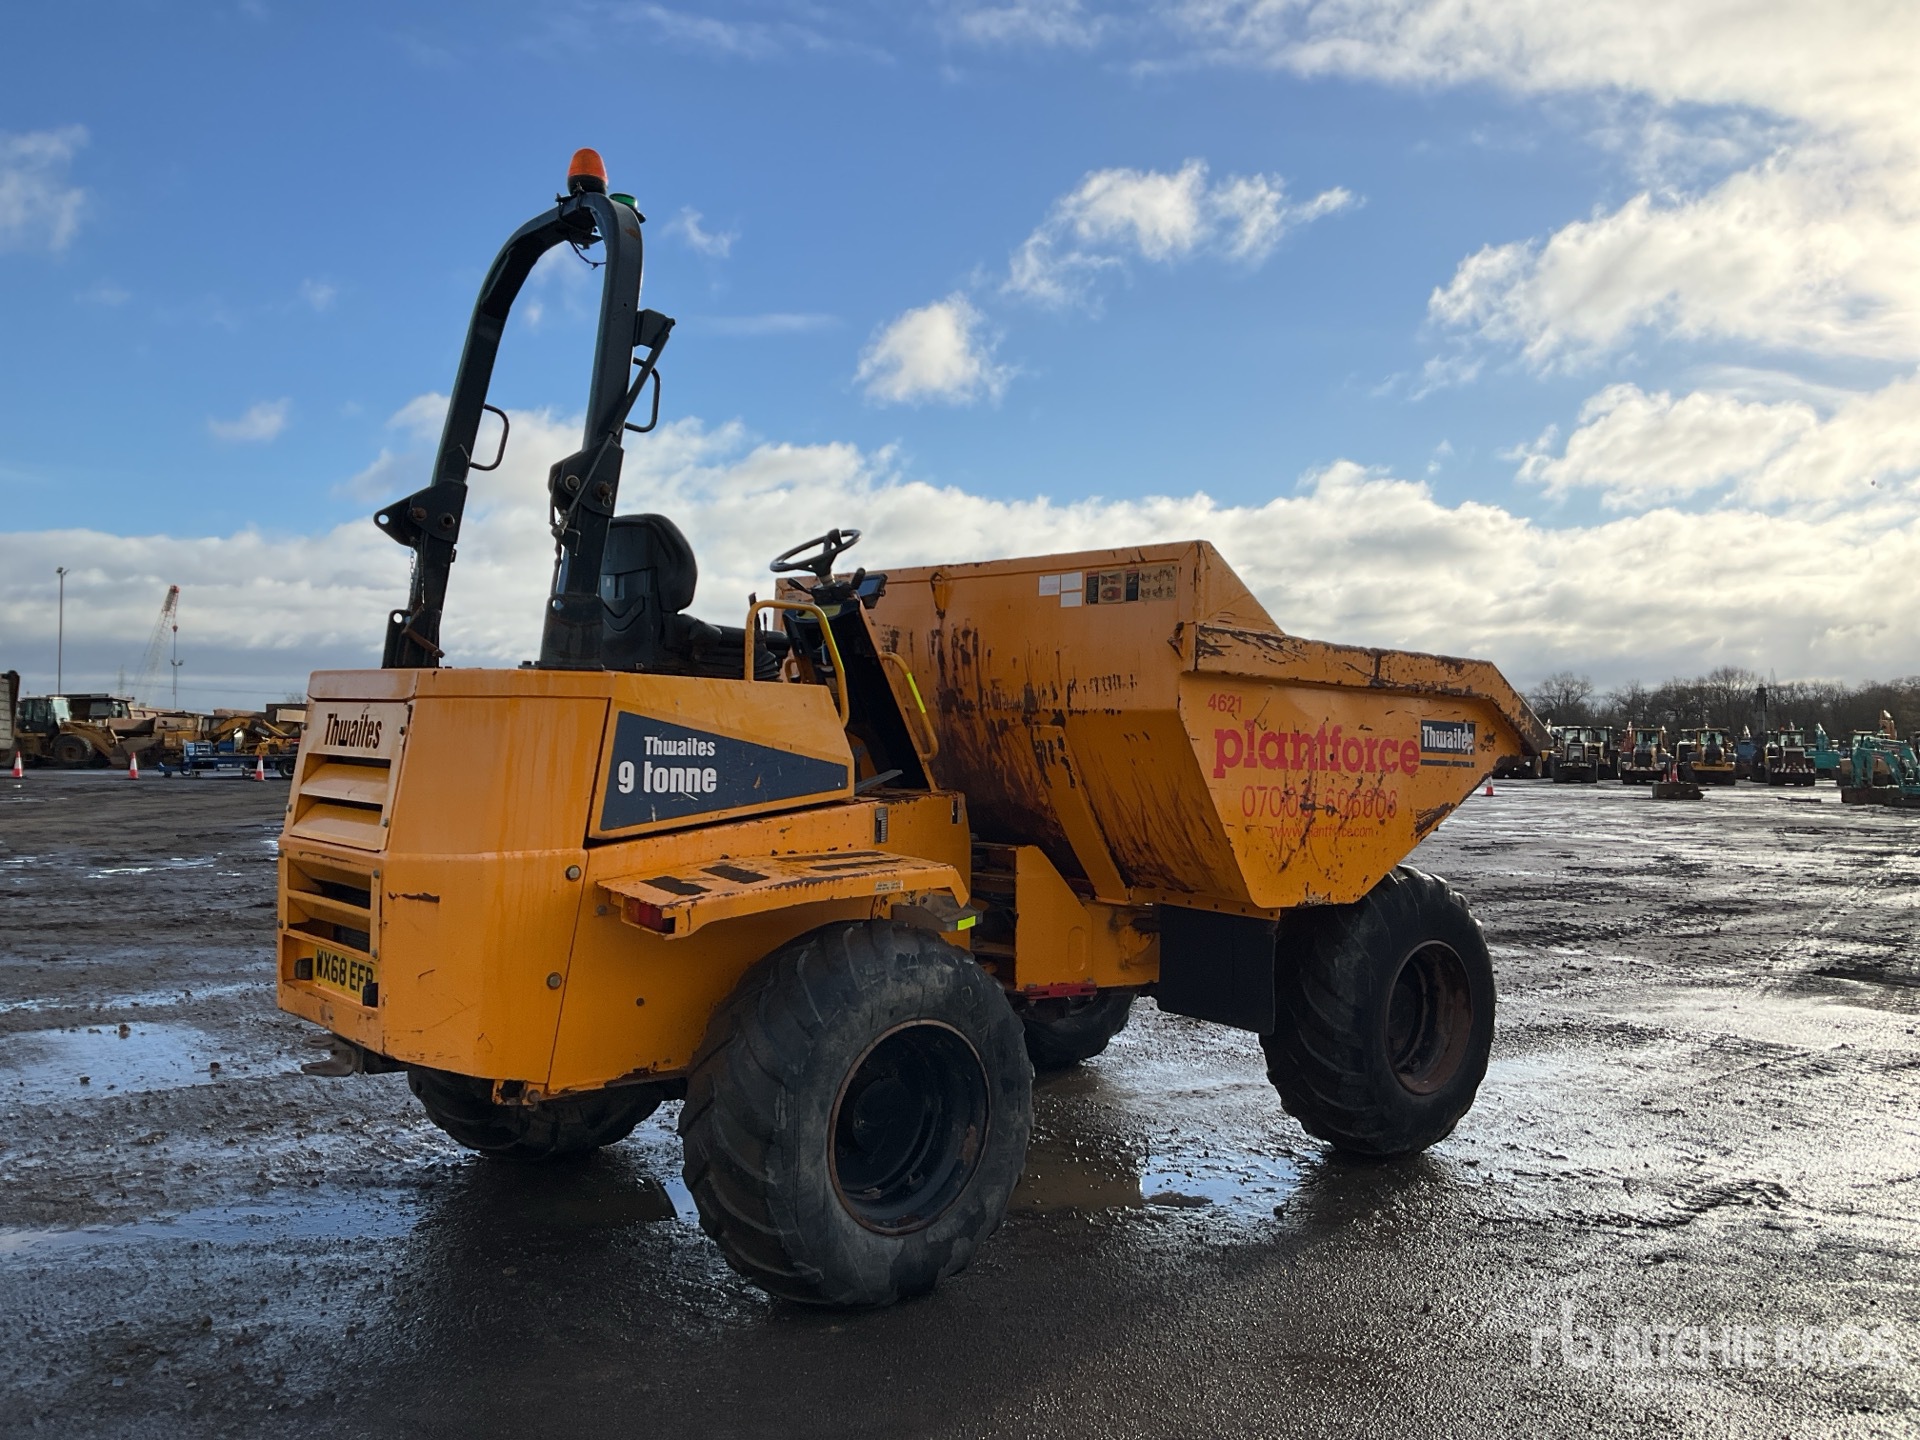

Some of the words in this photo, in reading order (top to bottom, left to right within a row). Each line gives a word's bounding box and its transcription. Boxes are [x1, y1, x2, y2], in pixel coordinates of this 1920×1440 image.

[1208, 693, 1242, 713] 4621
[324, 713, 382, 749] Thwaites
[644, 736, 716, 756] Thwaites
[1213, 719, 1420, 779] plantforce
[618, 761, 635, 794] 9
[643, 761, 717, 793] tonne
[316, 949, 348, 986] WX68
